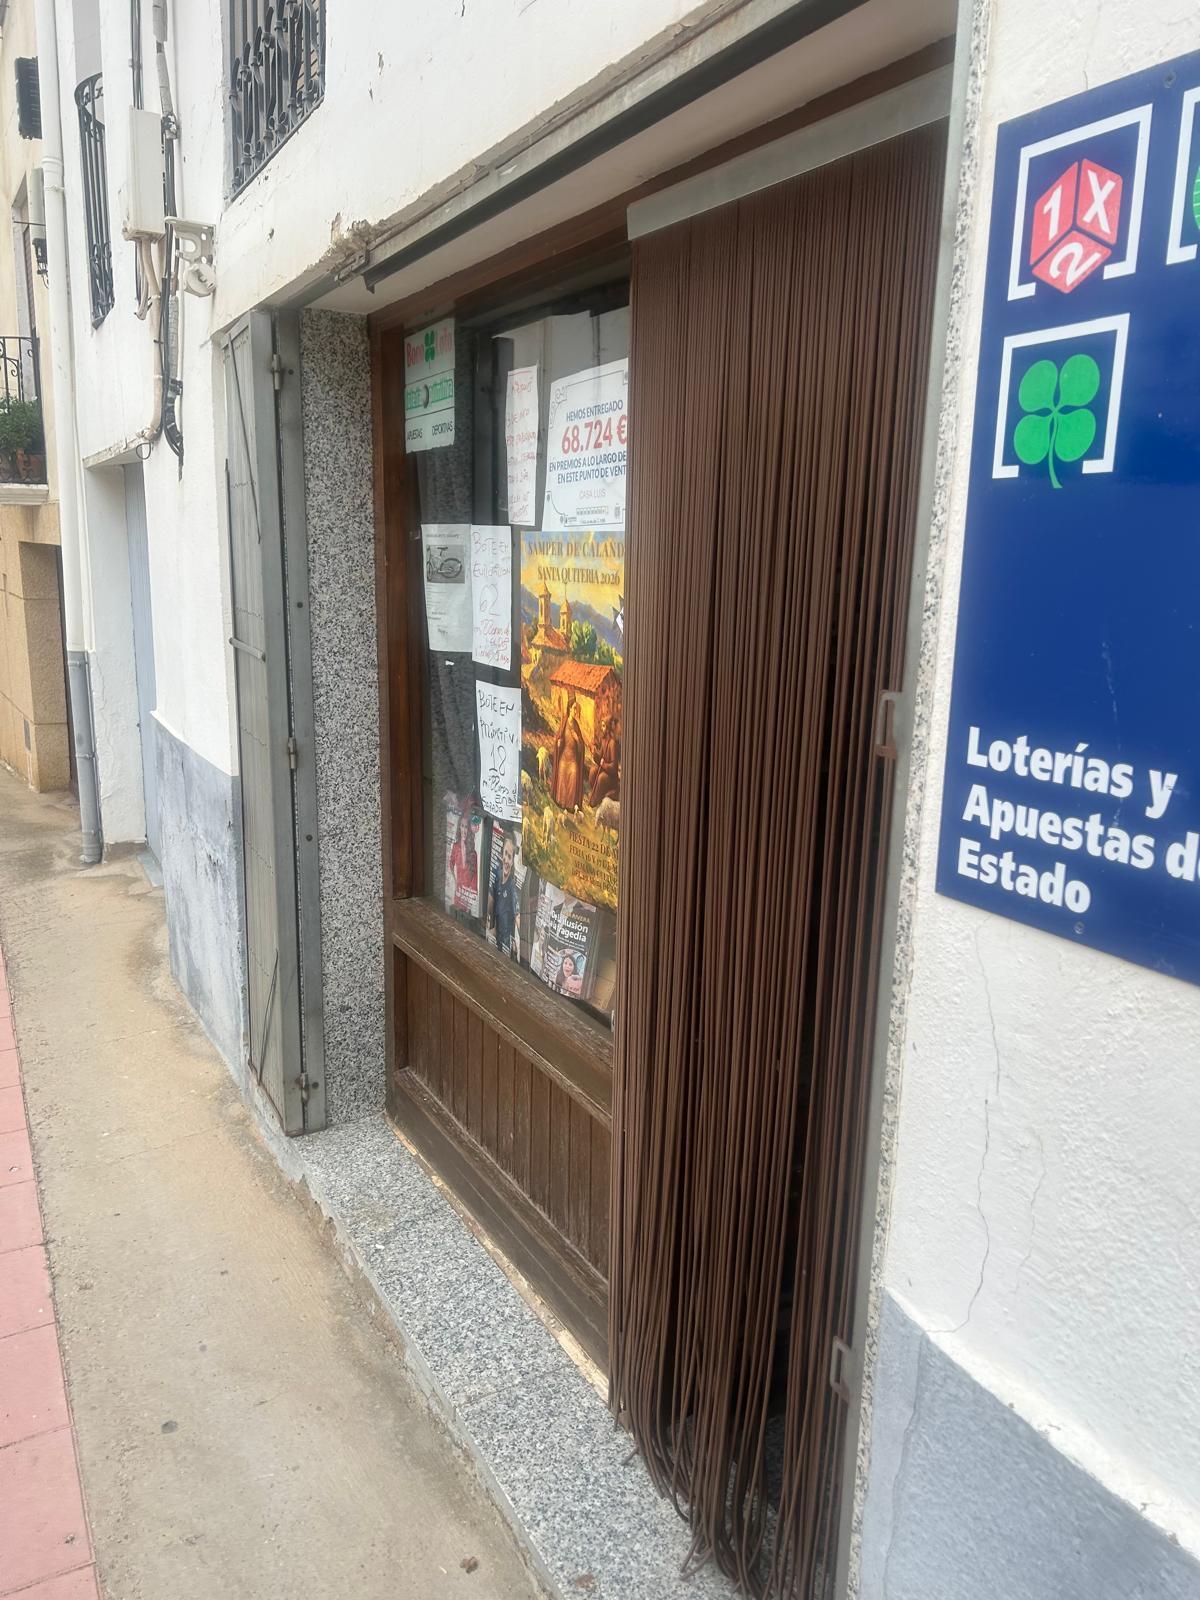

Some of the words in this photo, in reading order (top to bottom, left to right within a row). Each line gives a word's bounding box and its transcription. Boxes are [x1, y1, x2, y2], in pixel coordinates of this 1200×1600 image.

[566, 408, 586, 422] HEMOS
[586, 400, 624, 418] ENTREGADO
[562, 416, 613, 454] 68.724
[549, 462, 557, 472] EN
[557, 457, 582, 471] PREMIOS
[582, 456, 587, 468] A
[587, 455, 596, 467] LO
[596, 451, 618, 465] LARGO
[557, 473, 566, 484] EN
[566, 470, 579, 483] ESTE
[579, 467, 600, 481] PUNTO
[600, 466, 609, 478] DE
[609, 464, 628, 477] VENT
[579, 489, 593, 500] CASA
[593, 488, 606, 498] LUIS
[528, 541, 564, 556] SAMPER
[566, 541, 580, 557] DE
[582, 541, 624, 558] CALAND
[537, 566, 560, 581] SANTA
[561, 567, 599, 585] QUITERIA
[600, 572, 620, 585] 2026
[967, 726, 1134, 798] Loterías
[1145, 769, 1178, 819] y
[569, 830, 590, 849] FIESTA
[962, 784, 1155, 870] Apuestas
[1165, 831, 1200, 882] d
[957, 837, 1091, 914] Estado
